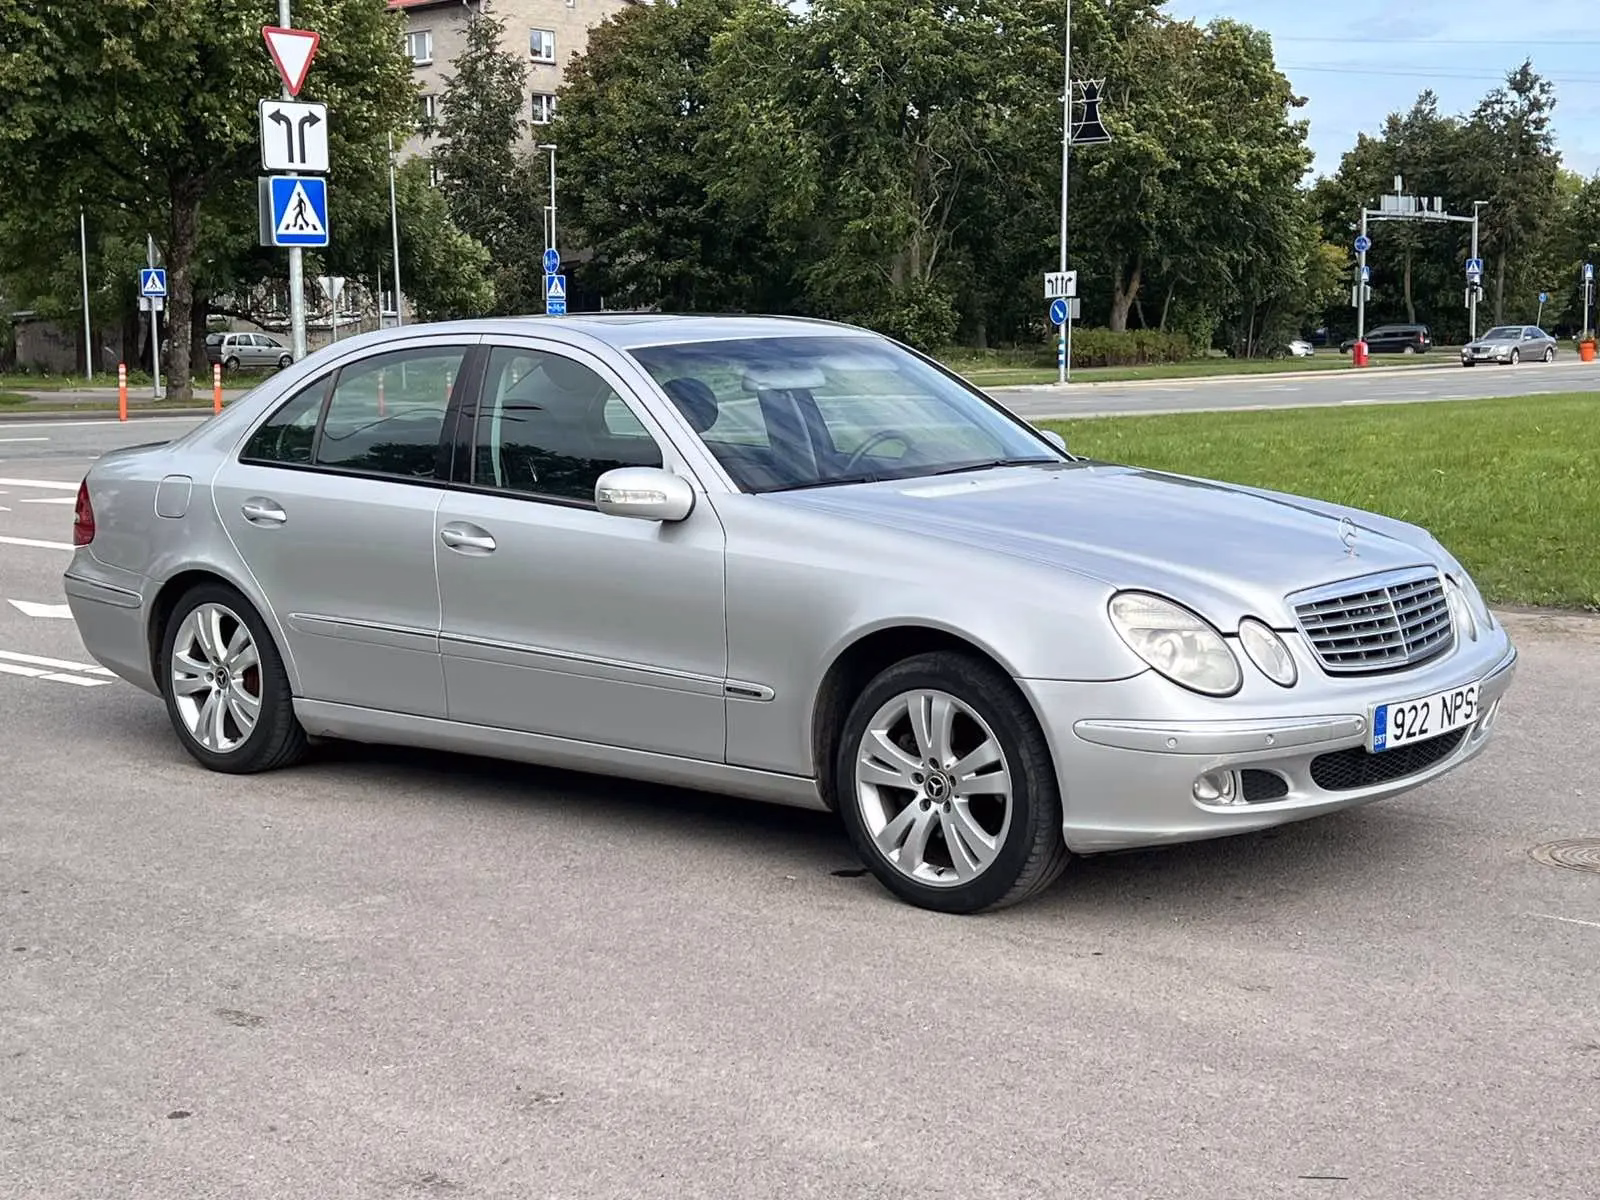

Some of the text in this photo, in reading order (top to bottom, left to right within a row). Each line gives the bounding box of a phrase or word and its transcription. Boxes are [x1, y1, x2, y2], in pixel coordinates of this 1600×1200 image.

[1393, 687, 1475, 741] 922 NPS
[1374, 734, 1387, 745] EST
